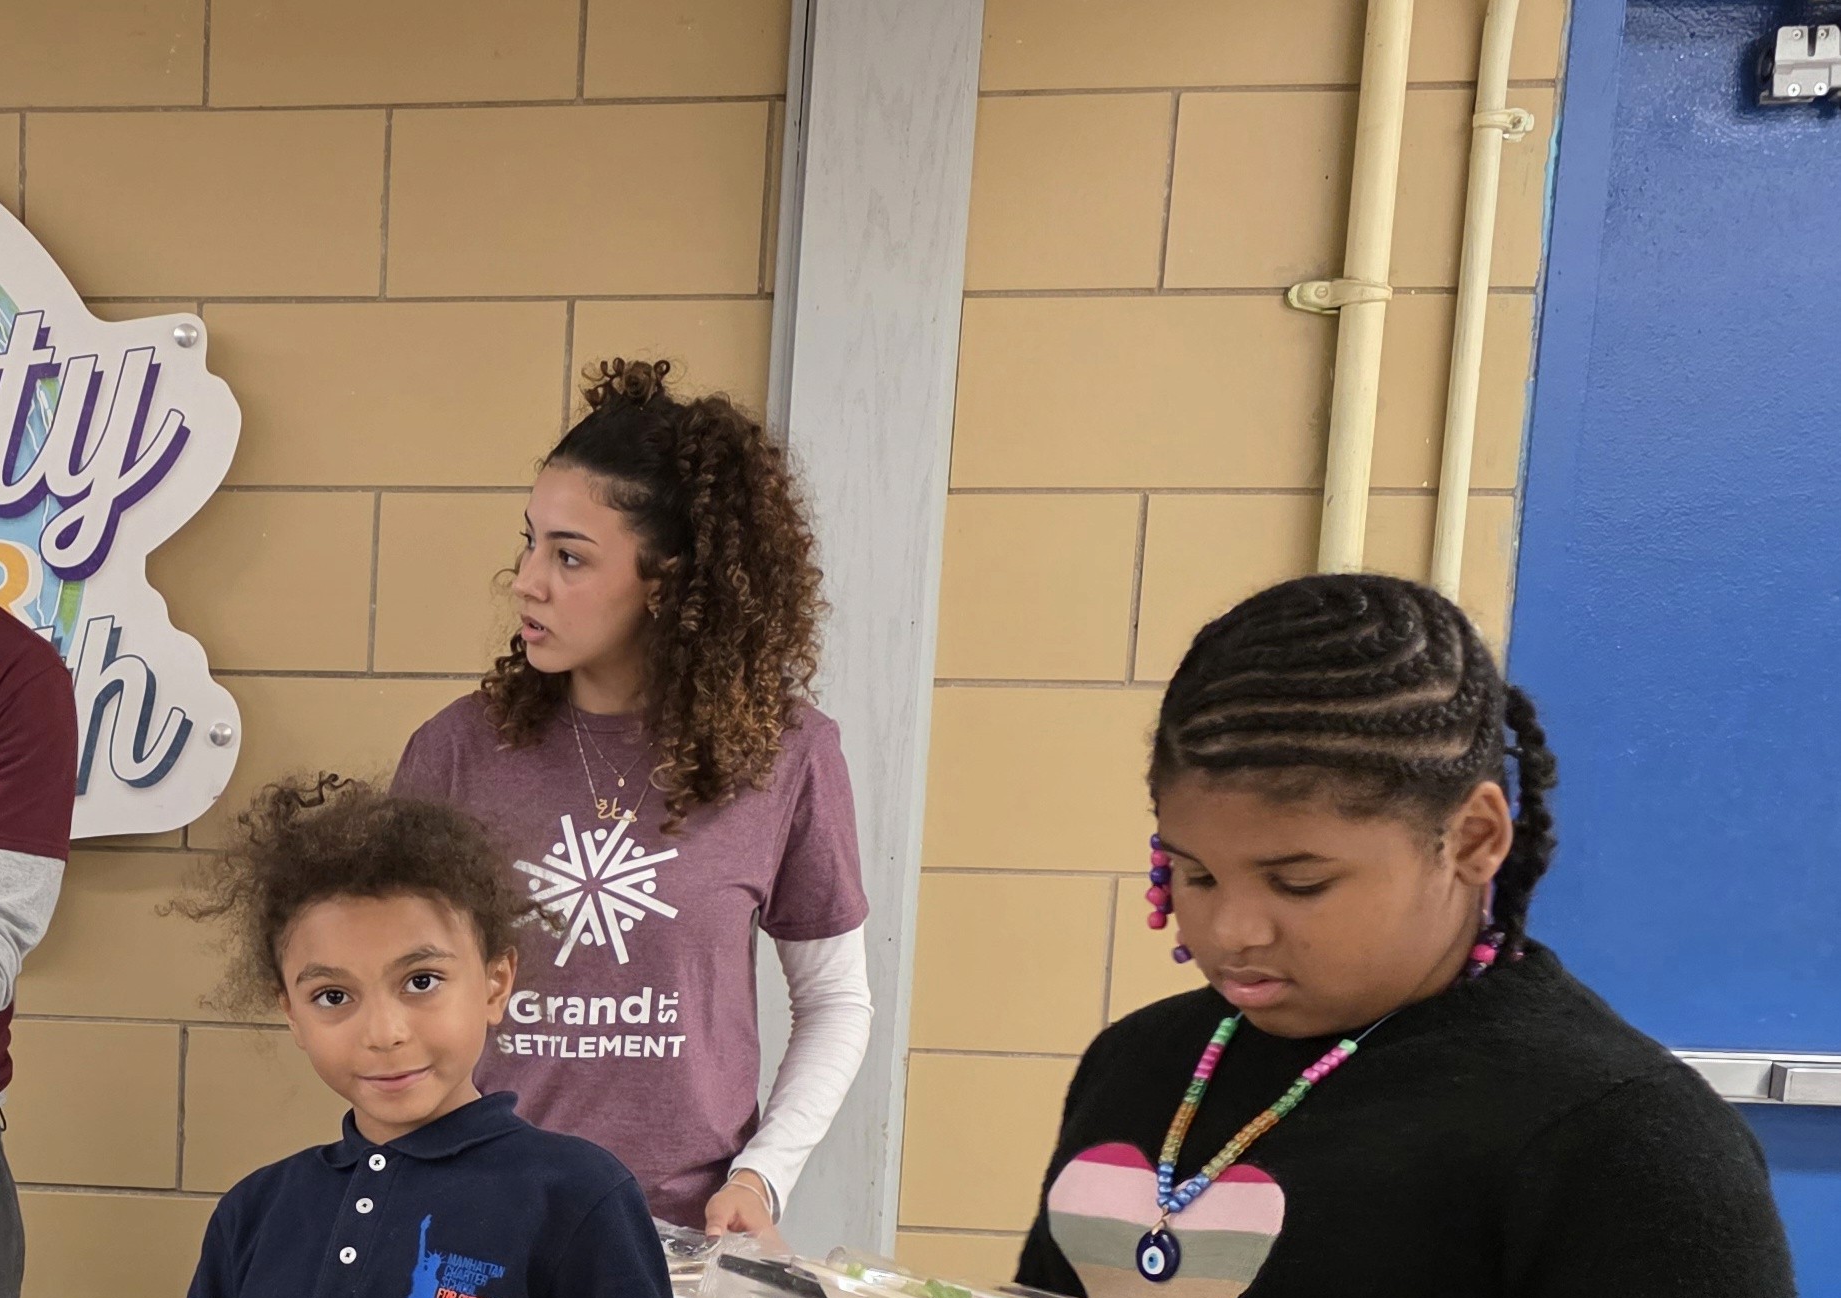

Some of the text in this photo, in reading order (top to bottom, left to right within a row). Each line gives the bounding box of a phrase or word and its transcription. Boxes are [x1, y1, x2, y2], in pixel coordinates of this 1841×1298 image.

[509, 987, 680, 1025] Grand ST.
[497, 1034, 686, 1058] SETTLEMENT
[447, 1253, 505, 1278] MANHATTAN
